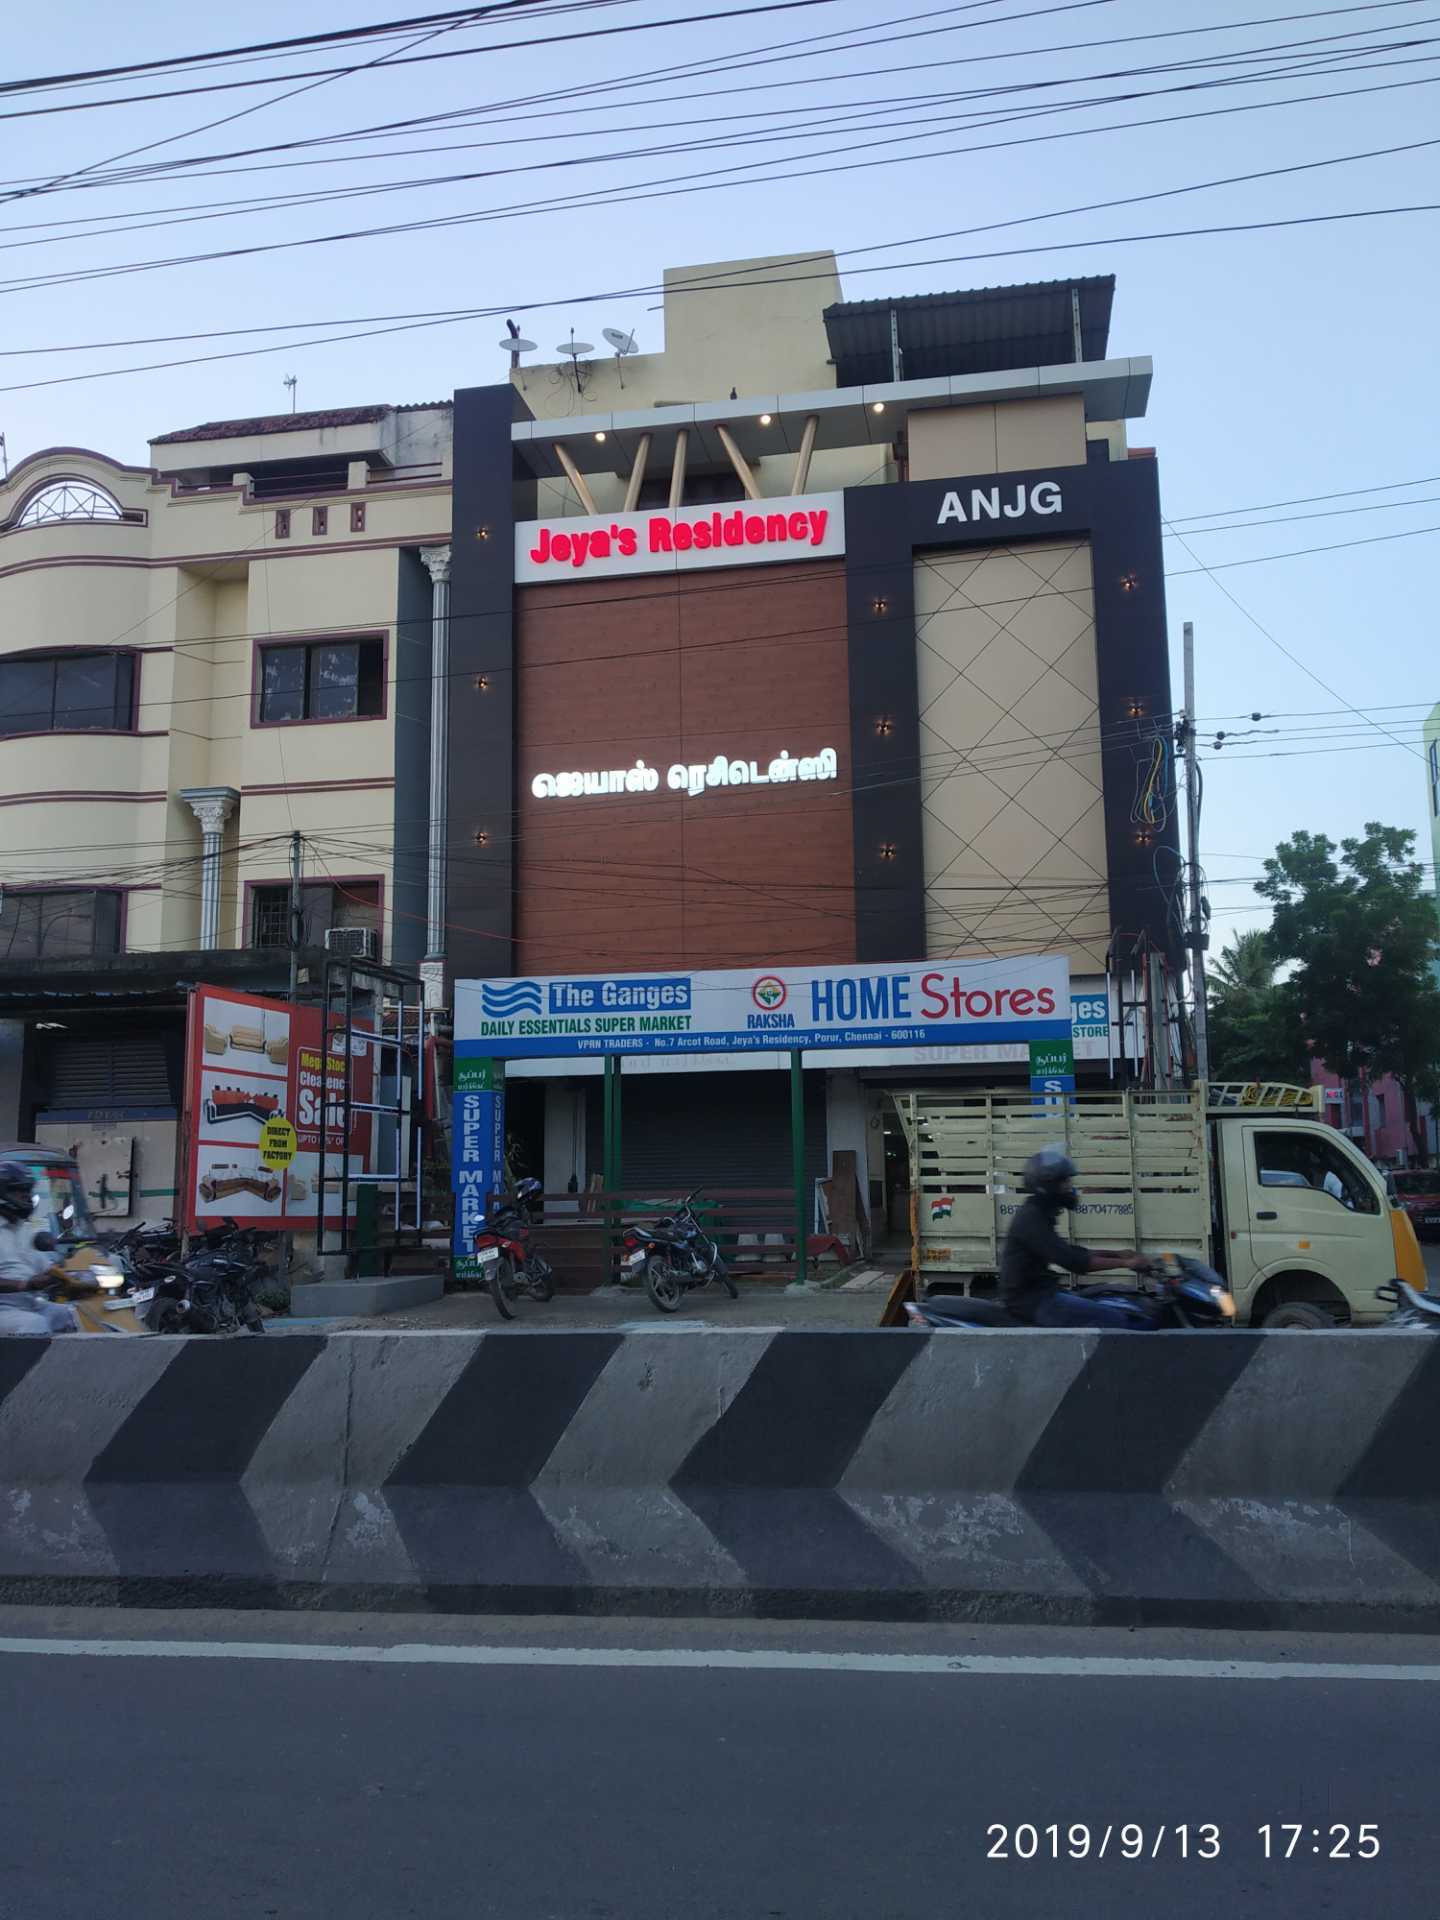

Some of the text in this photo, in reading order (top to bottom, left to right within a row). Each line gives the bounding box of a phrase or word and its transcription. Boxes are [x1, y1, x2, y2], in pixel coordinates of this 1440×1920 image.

[937, 482, 1063, 525] ANJG
[530, 508, 829, 567] Jeya's Residency
[552, 981, 688, 1009] The Ganges
[811, 972, 1055, 1021] HOME Stores
[481, 1015, 691, 1036] DAILY ESSENTIALS SUPER MARKET
[748, 1013, 795, 1030] RAKSHA
[603, 1038, 643, 1049] TRADERS
[654, 1037, 675, 1048] No.7
[678, 1036, 701, 1047] Arcot
[732, 1034, 760, 1047] Jeya's
[845, 1031, 882, 1042] Chennai
[891, 1029, 926, 1040] 600116
[327, 1056, 345, 1073] Stoc
[266, 1126, 291, 1137] DIRECT
[463, 1094, 480, 1162] SUPER
[493, 1095, 501, 1161] SUPER
[269, 1138, 288, 1148] FROM
[263, 1150, 293, 1161] FACTORY
